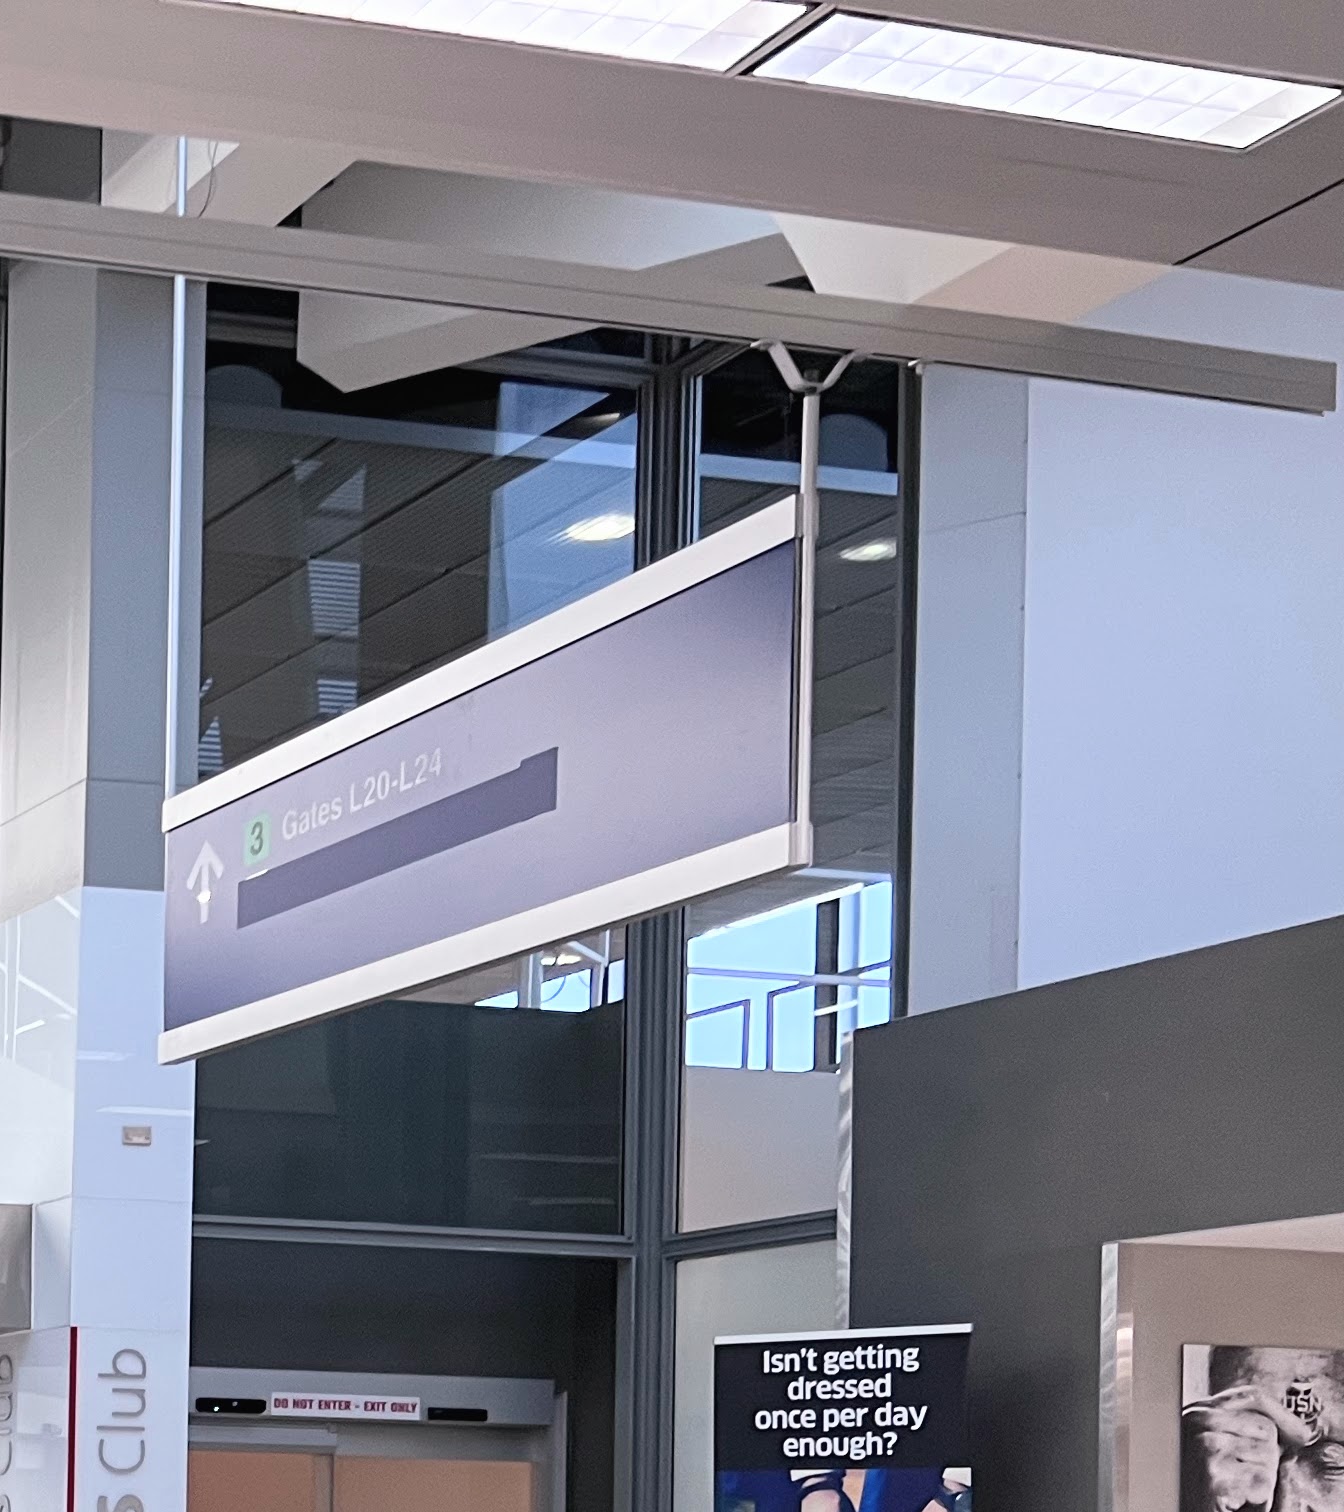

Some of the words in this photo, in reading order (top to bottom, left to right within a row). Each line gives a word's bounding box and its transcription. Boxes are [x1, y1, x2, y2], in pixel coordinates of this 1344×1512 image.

[249, 821, 265, 857] 3
[281, 795, 343, 842] Gates
[349, 747, 443, 814] L20-L24
[763, 1348, 817, 1373] Isn't
[823, 1343, 920, 1374] getting
[787, 1373, 892, 1400] dressed
[98, 1347, 148, 1476] Club
[274, 1397, 289, 1408] DO
[293, 1398, 314, 1409] NOT
[318, 1399, 352, 1411] ENTER
[364, 1401, 387, 1412] EXIT
[391, 1402, 418, 1413] ONLY
[755, 1408, 816, 1430] once
[823, 1405, 868, 1432] per
[874, 1402, 928, 1430] day
[1283, 1395, 1322, 1412] USN
[783, 1431, 898, 1460] enough?
